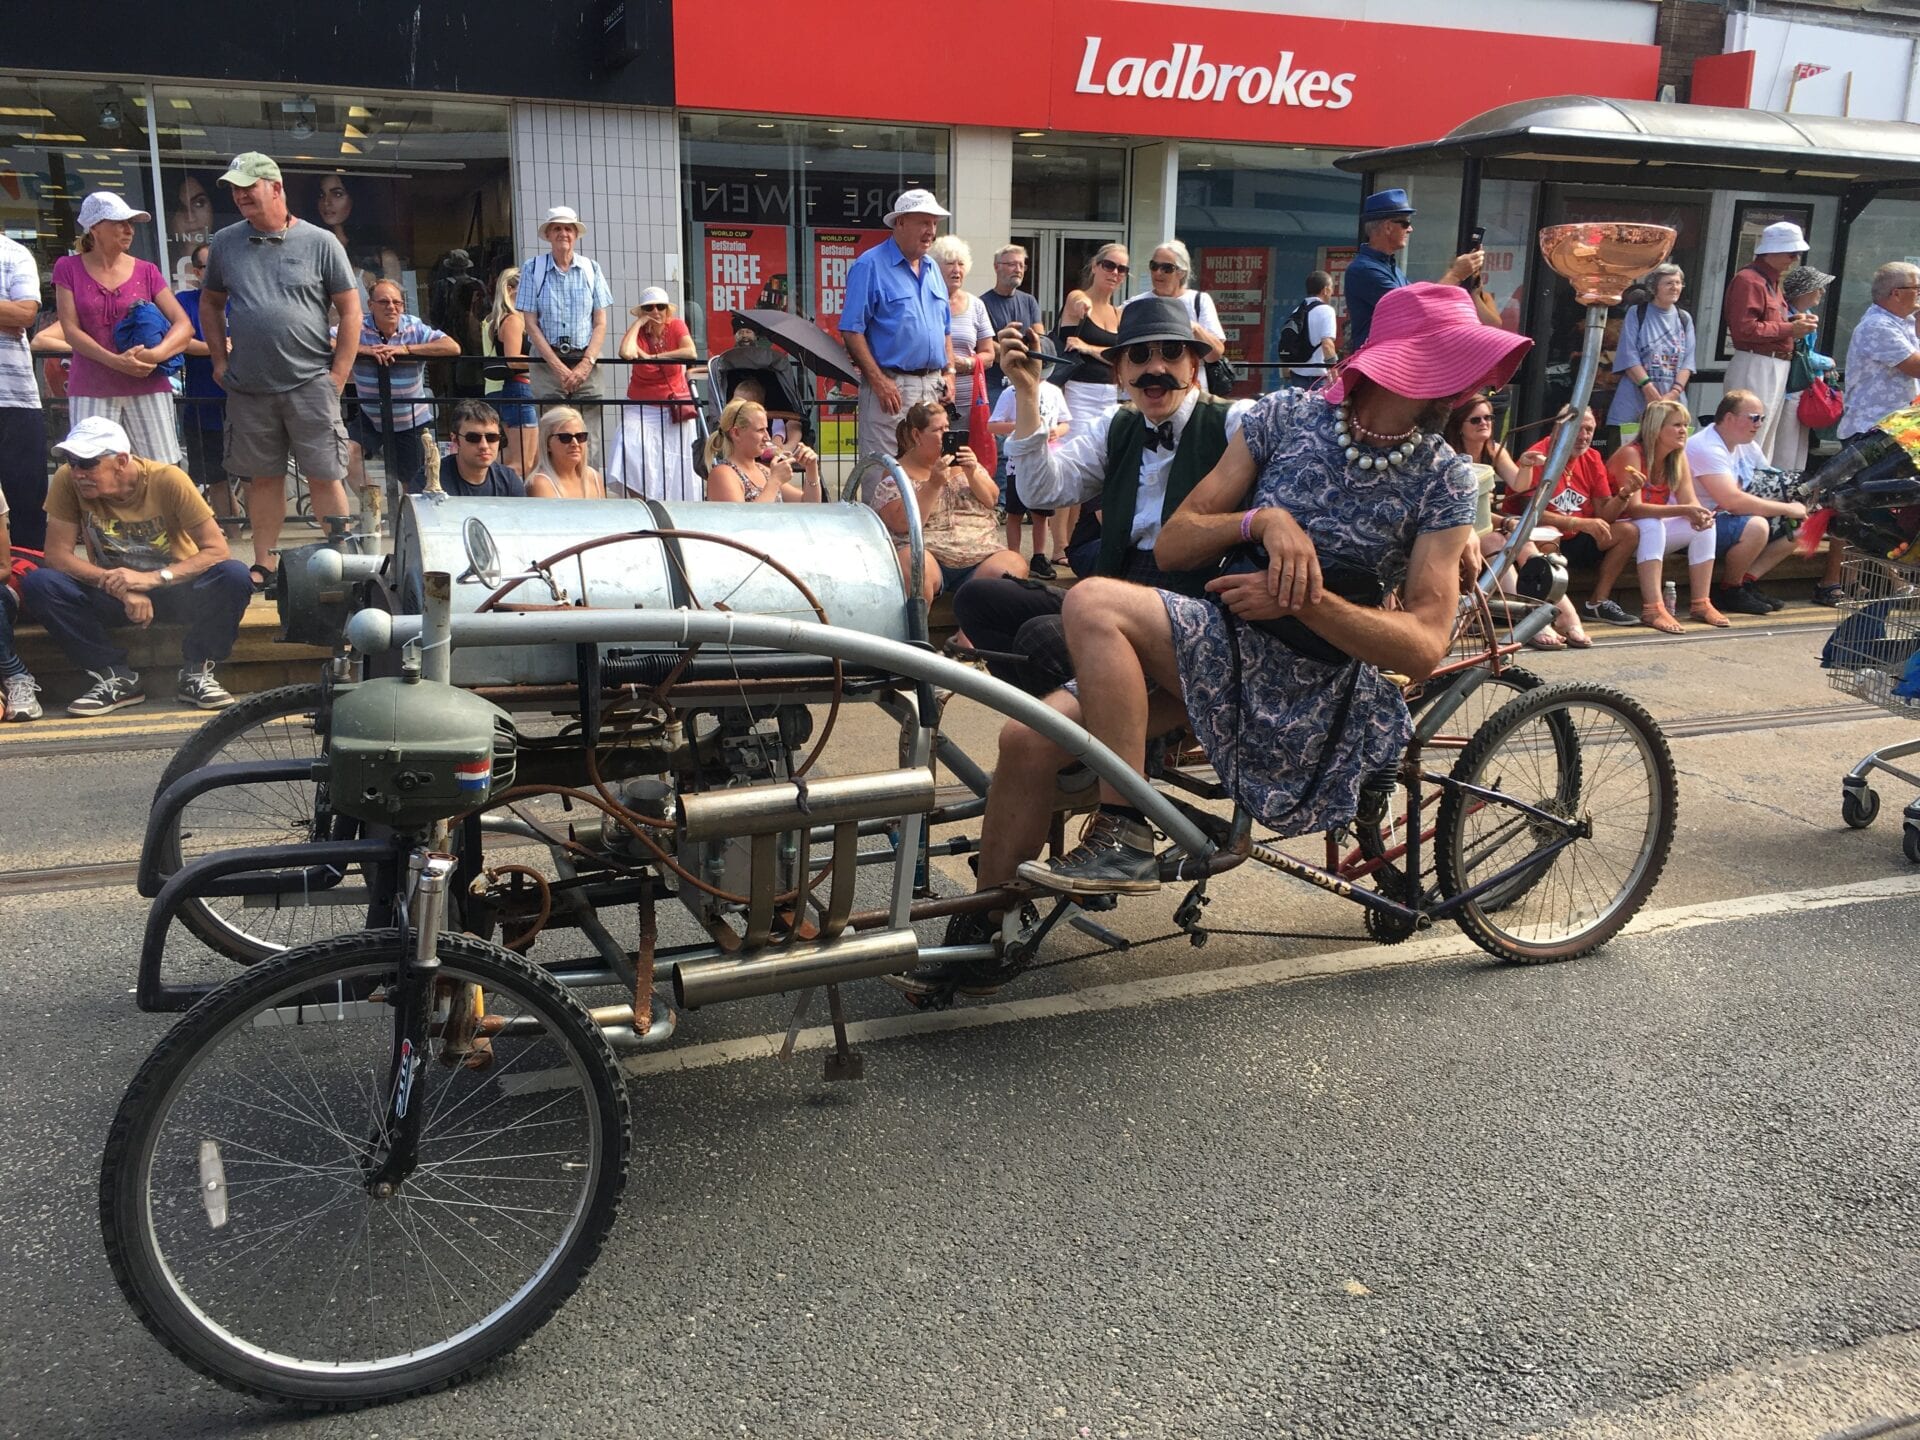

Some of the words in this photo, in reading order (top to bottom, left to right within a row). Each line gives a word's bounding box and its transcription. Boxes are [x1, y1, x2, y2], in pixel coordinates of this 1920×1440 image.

[1075, 36, 1356, 109] Ladbrokes
[166, 232, 215, 243] LINGE
[711, 240, 747, 251] BetStation
[821, 245, 855, 256] BetStation
[712, 253, 761, 285] FREE
[1206, 256, 1243, 270] WHAT'S
[1245, 256, 1263, 269] THE
[1215, 270, 1252, 284] SCORE?
[821, 288, 847, 315] BE
[1220, 292, 1246, 300] FRANCE
[1252, 844, 1301, 870] UDDY
